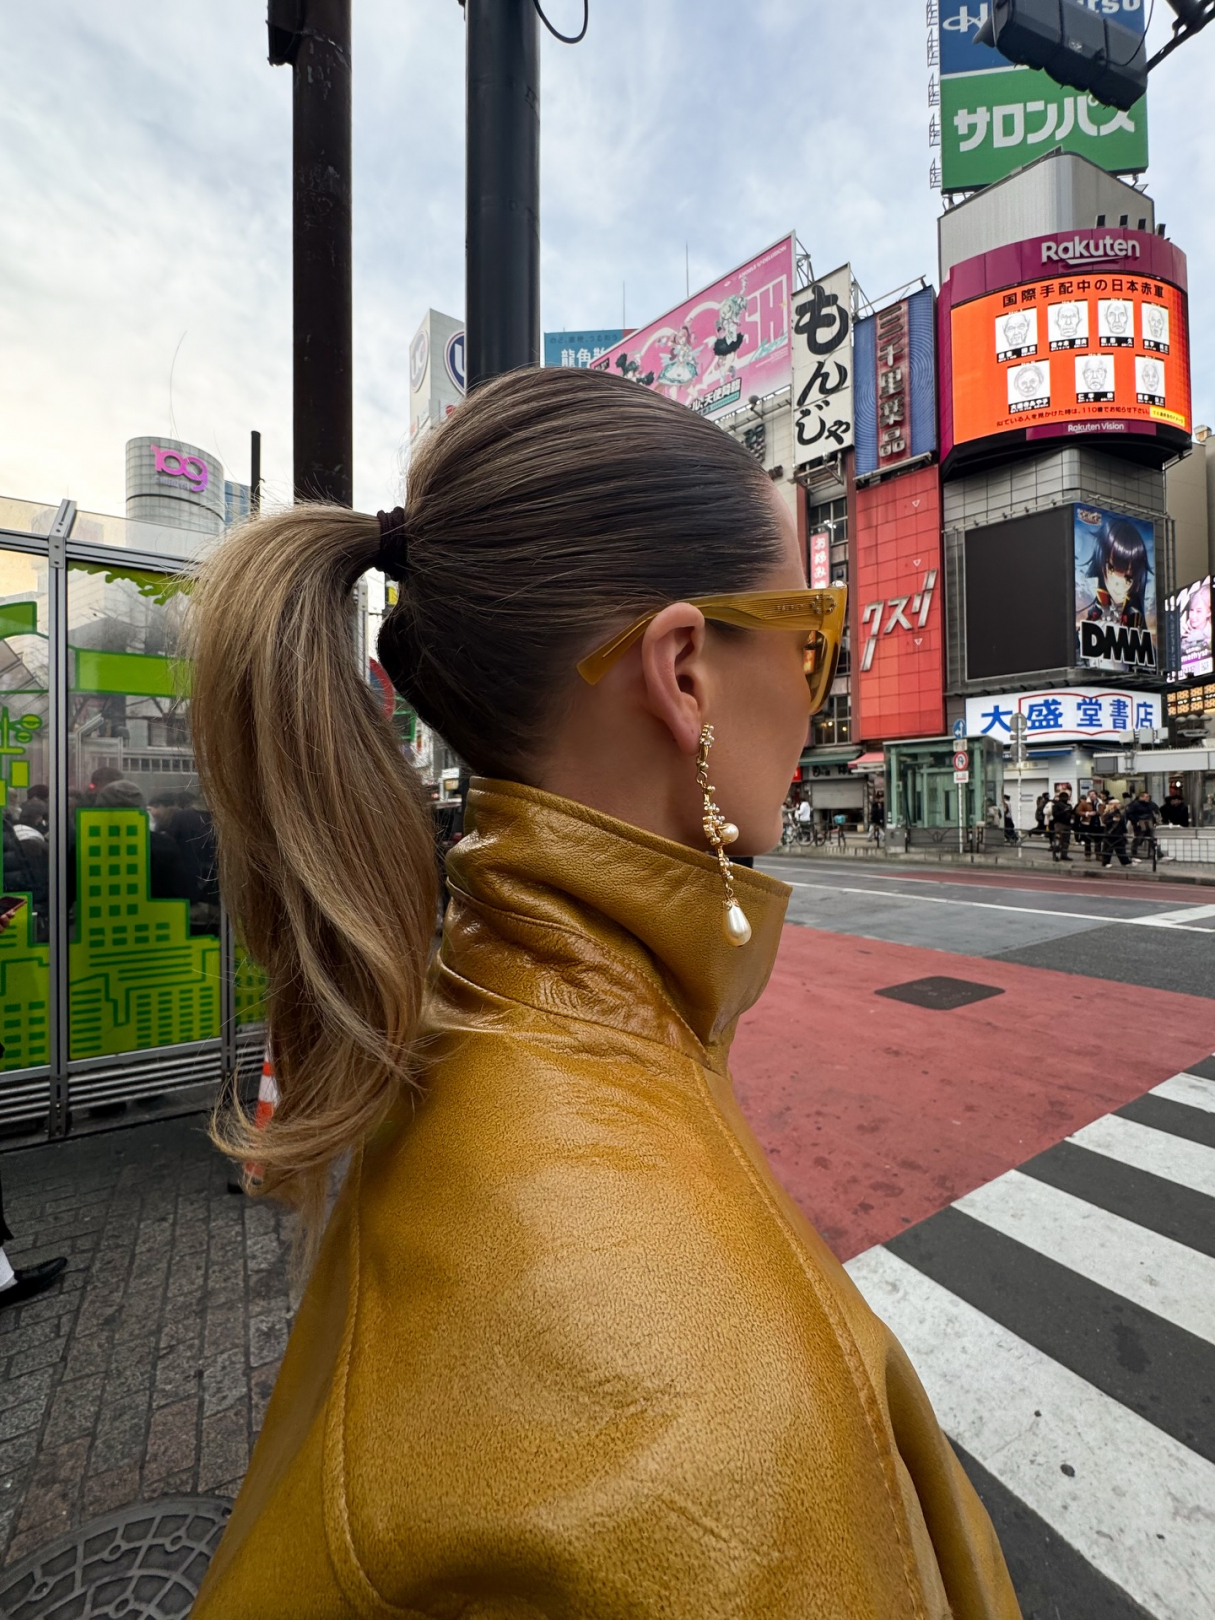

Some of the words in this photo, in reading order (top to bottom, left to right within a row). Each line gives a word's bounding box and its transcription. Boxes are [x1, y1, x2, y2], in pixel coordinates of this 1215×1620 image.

[1041, 235, 1140, 264] Rakuten
[1003, 279, 1164, 308] 国際手配中の日本赤軍
[794, 284, 851, 446] もんじゃ
[878, 304, 905, 458] 三千里薬品
[1068, 423, 1100, 433] Rakuten
[1101, 421, 1124, 430] Vision
[150, 444, 208, 492] 109
[860, 569, 938, 672] クスリ
[1081, 621, 1155, 666] DMM
[980, 697, 1154, 734] 大盛堂書店
